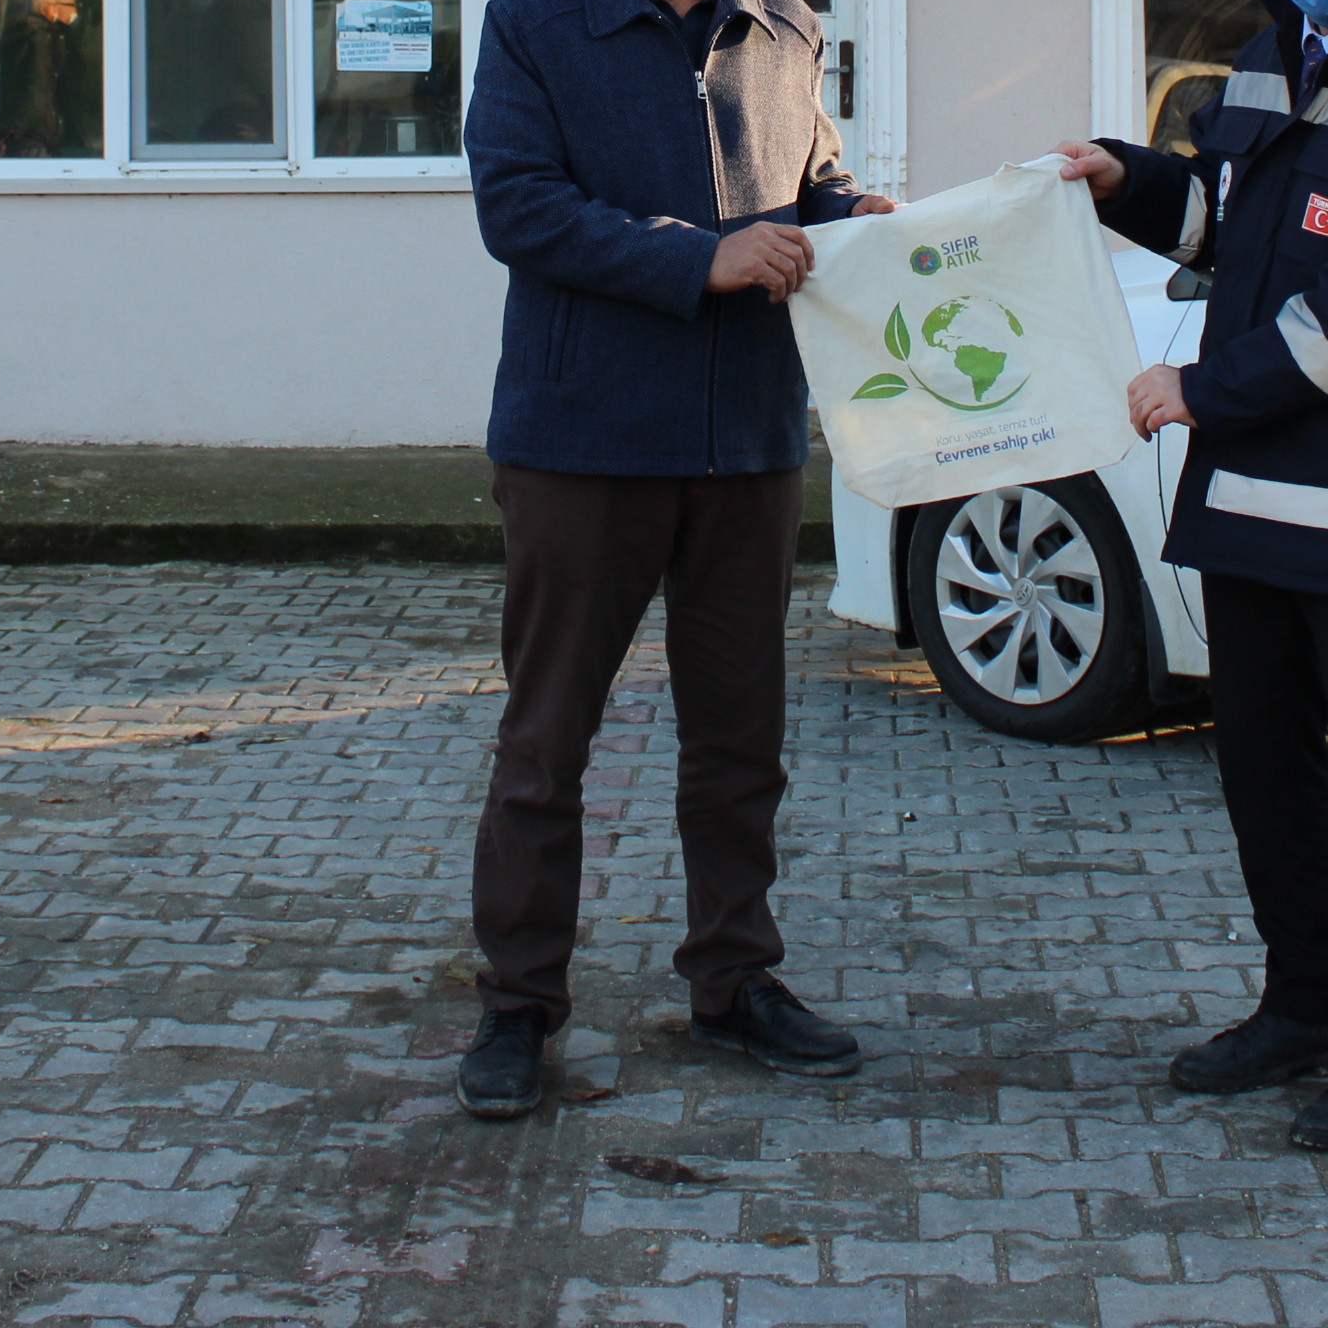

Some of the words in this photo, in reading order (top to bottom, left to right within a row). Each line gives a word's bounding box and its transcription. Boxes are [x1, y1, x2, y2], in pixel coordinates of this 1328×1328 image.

[941, 235, 979, 255] SIFIR
[946, 248, 982, 269] ATIK
[998, 419, 1027, 433] temiz
[935, 443, 991, 467] Çevrene
[993, 434, 1028, 450] sahip
[1032, 426, 1056, 446] çık!
